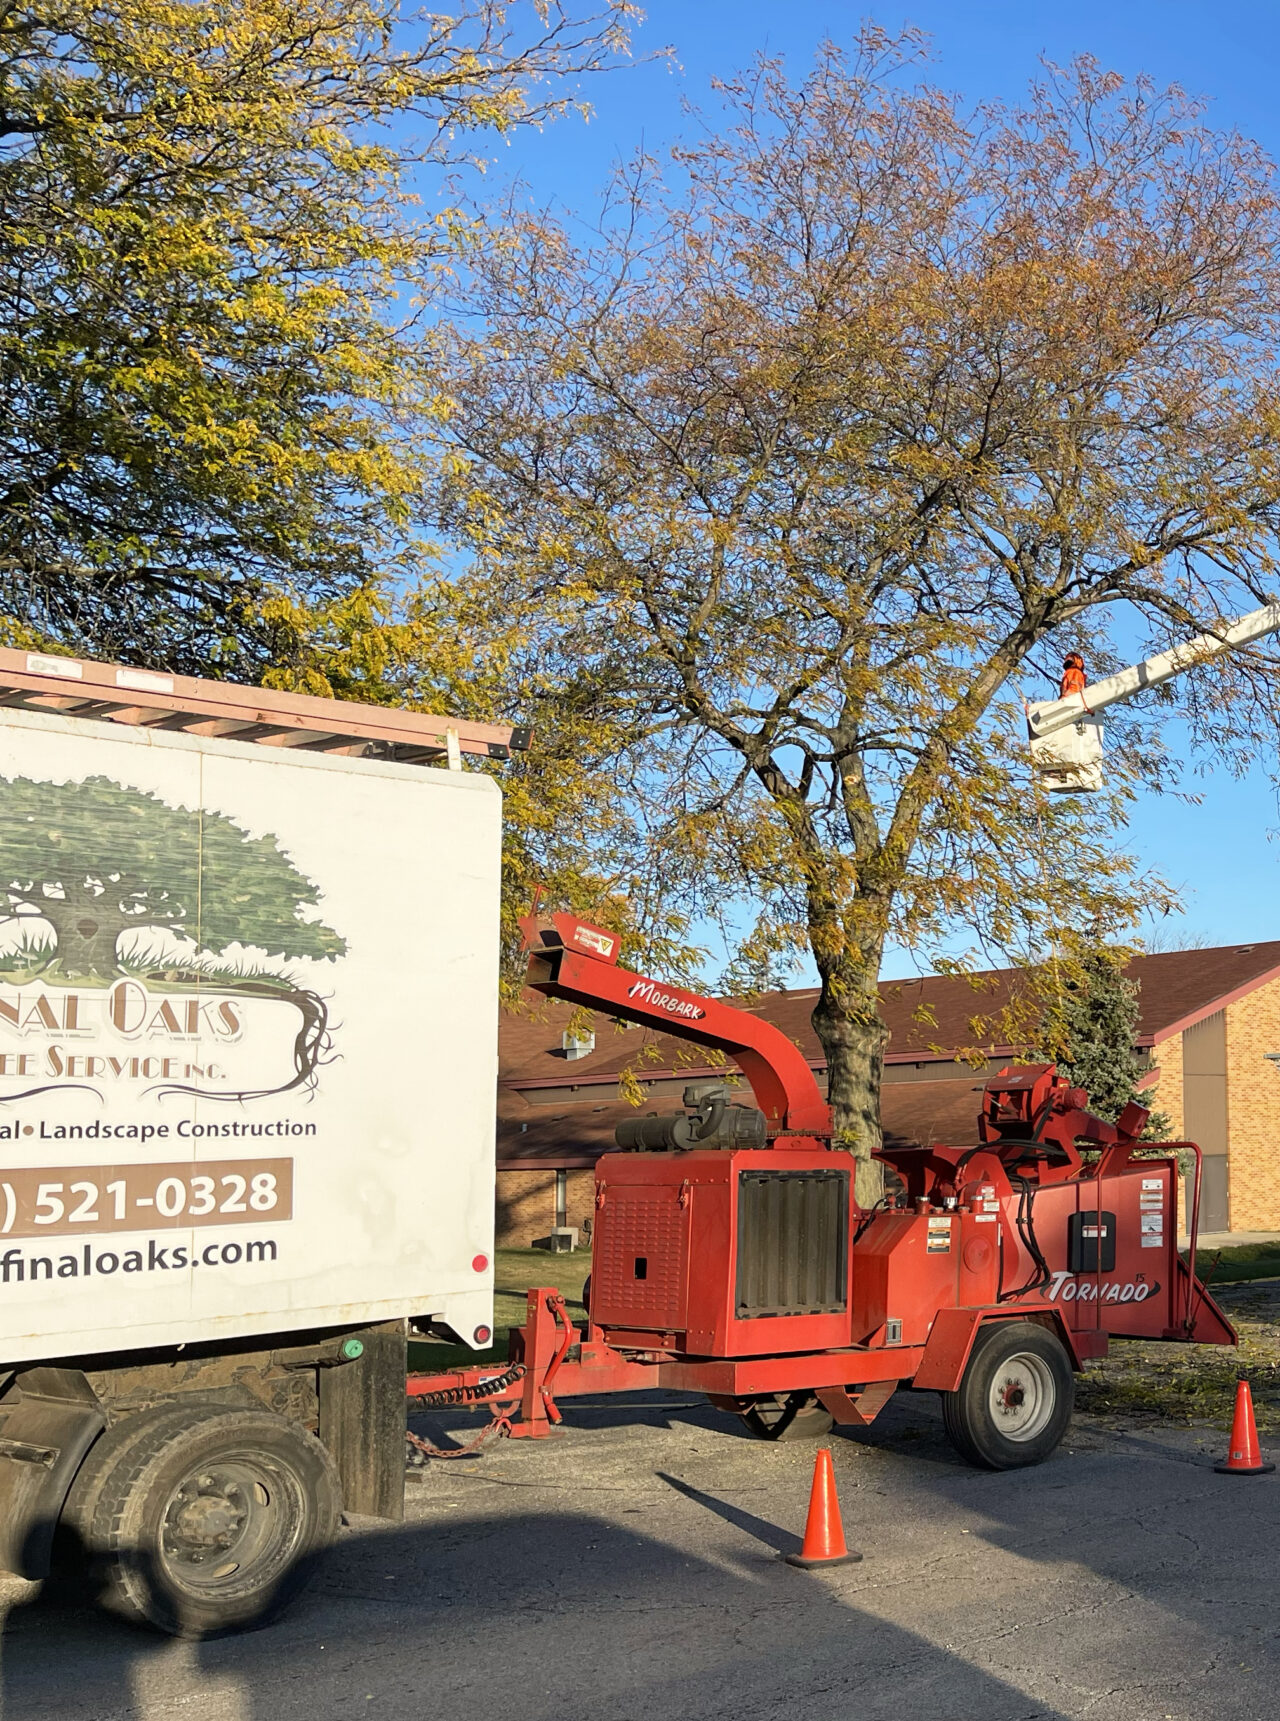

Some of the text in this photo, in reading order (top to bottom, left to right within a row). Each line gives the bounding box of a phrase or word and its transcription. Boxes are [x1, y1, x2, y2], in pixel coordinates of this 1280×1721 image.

[109, 981, 241, 1036] OAKS
[628, 981, 702, 1020] MORBARK
[45, 1045, 179, 1078] SERVICE
[184, 1063, 227, 1079] INC.
[39, 1119, 170, 1142] Landscape
[176, 1118, 318, 1138] Construction
[33, 1172, 279, 1225] 521-0328
[0, 1238, 278, 1283] finaloaks.com
[1048, 1271, 1149, 1302] TORNADO
